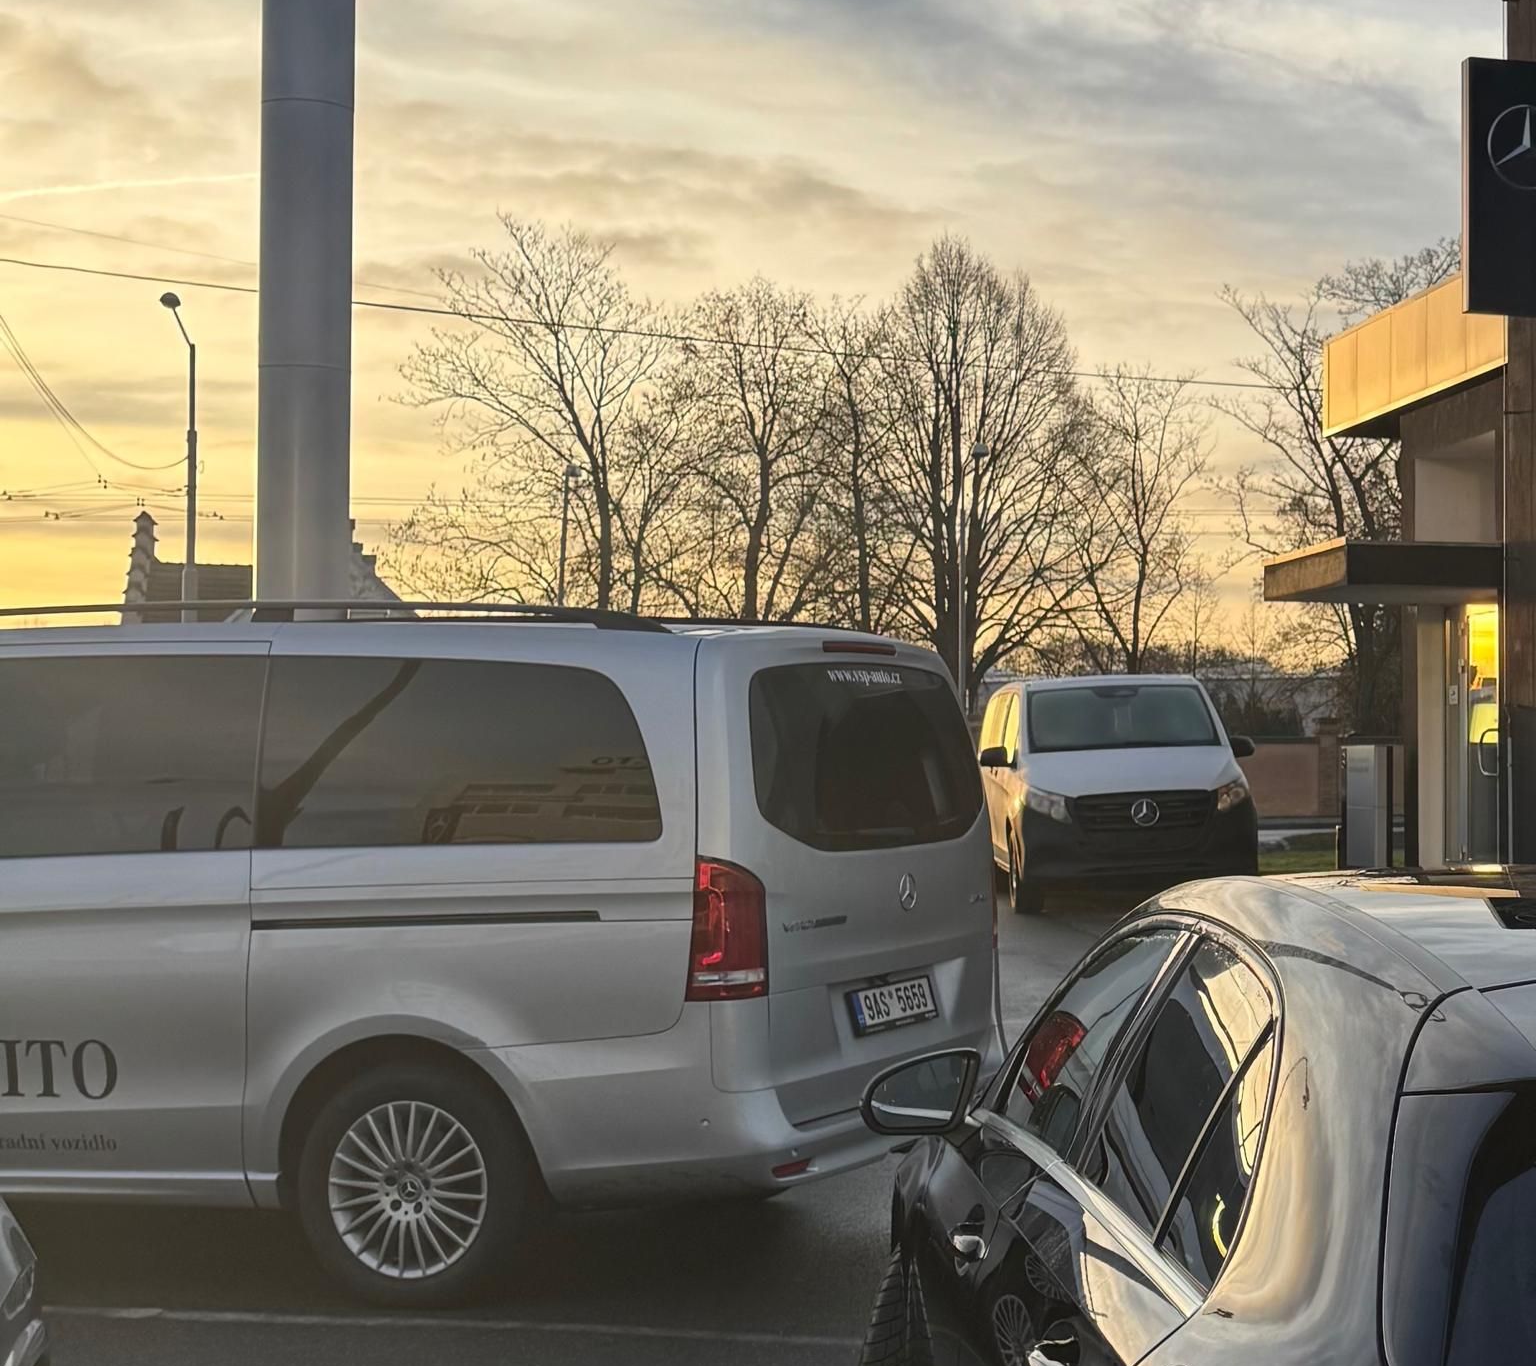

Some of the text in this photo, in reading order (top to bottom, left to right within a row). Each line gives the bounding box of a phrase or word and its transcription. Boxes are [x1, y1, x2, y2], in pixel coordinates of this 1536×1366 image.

[864, 983, 928, 1021] 9AS 5659
[51, 1133, 118, 1151] vozidlo
